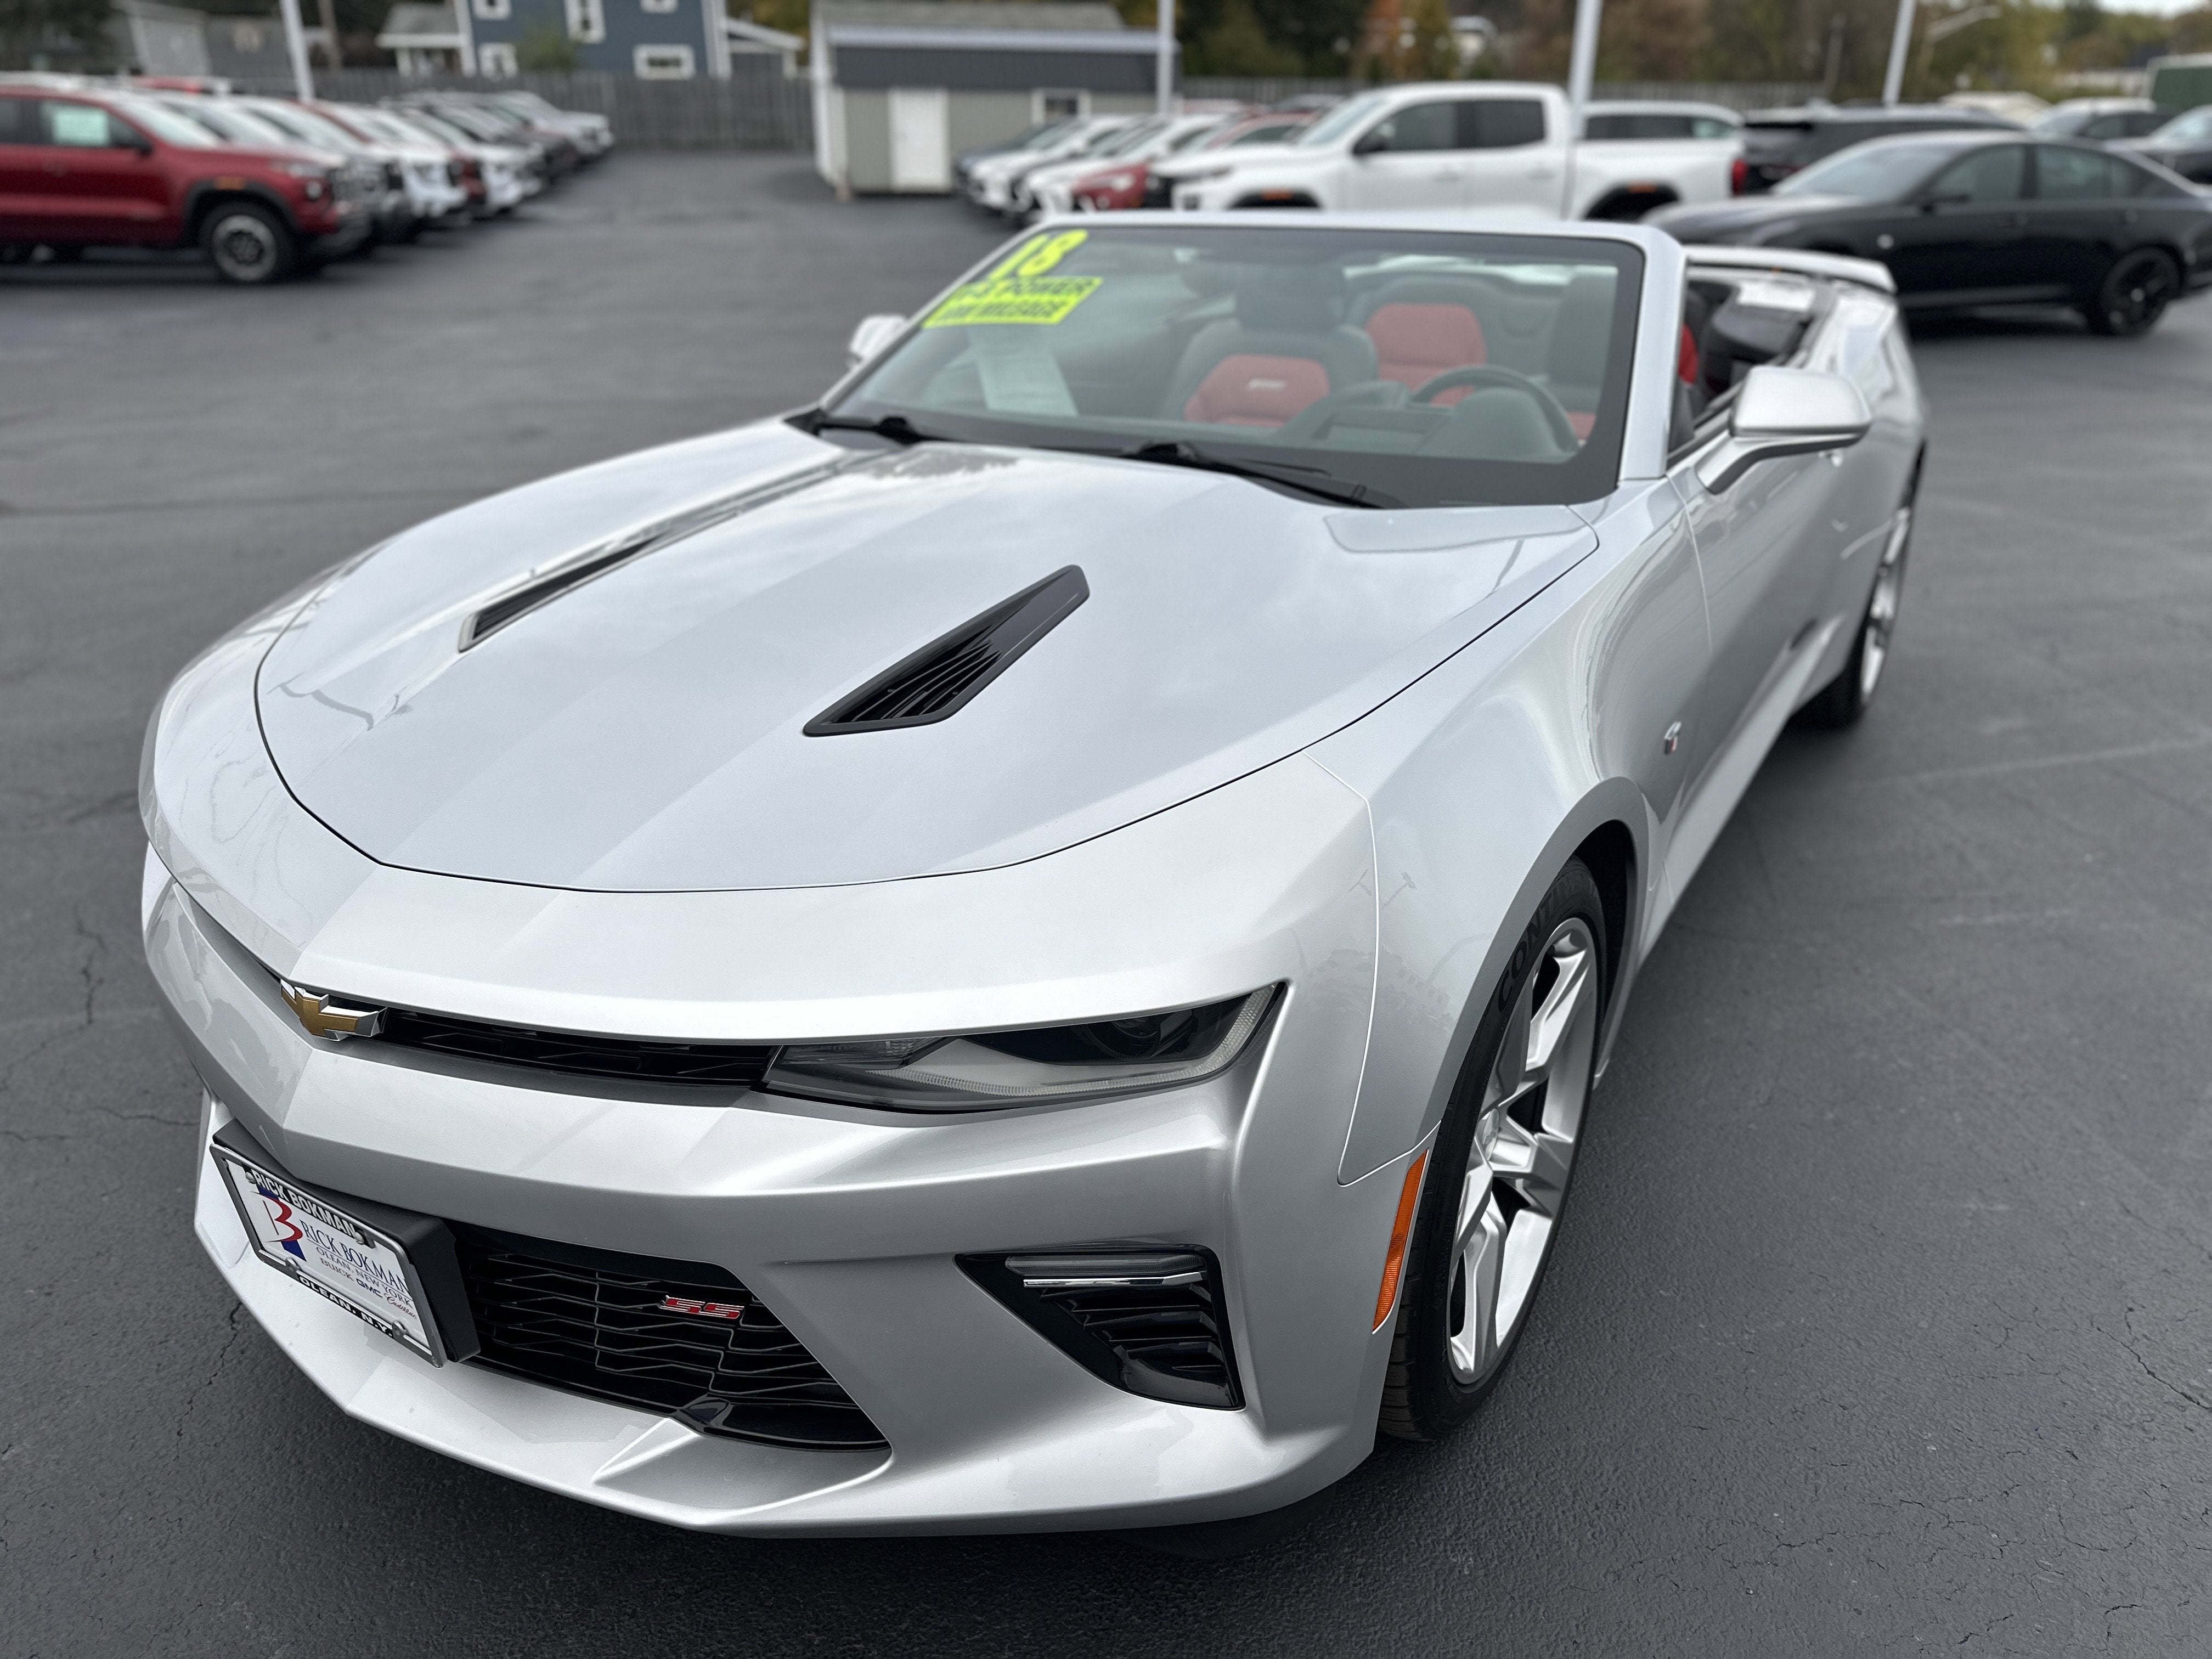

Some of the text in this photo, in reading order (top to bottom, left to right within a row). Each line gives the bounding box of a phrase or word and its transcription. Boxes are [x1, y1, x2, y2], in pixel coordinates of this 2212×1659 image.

[989, 229, 1088, 279] 18
[251, 1169, 356, 1238] RICK BOKMAN
[299, 1219, 413, 1300] RICK BOKMAN
[320, 1257, 354, 1282] BUICK
[356, 1278, 383, 1299] GMC
[356, 1269, 380, 1288] NEW
[381, 1283, 414, 1308] YORK
[659, 1295, 744, 1319] SS
